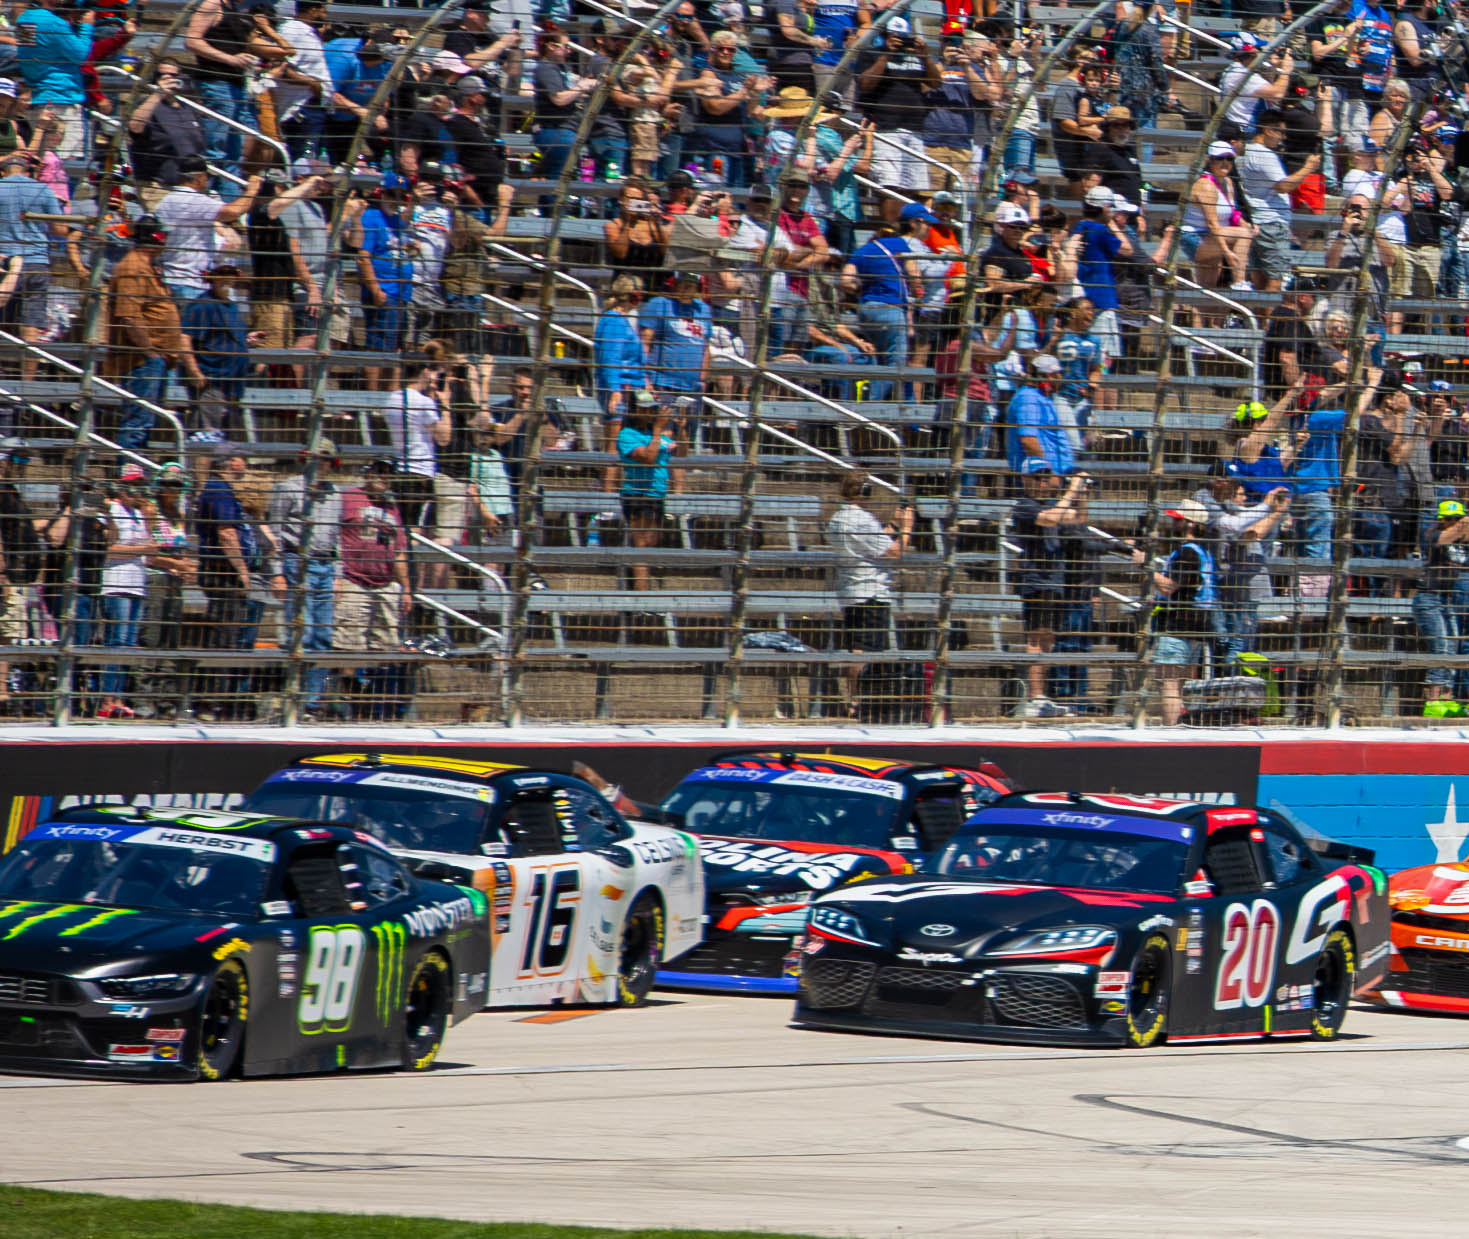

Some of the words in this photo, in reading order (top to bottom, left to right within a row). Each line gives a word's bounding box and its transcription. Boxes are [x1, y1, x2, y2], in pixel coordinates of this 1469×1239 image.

[281, 769, 354, 782] xfinity
[702, 768, 769, 781] xfinity
[1041, 811, 1115, 829] xfinity
[45, 825, 123, 839] xfinity
[157, 832, 254, 852] HERBST
[515, 861, 584, 981] 16
[1214, 897, 1281, 1011] 20
[300, 924, 367, 1035] 98
